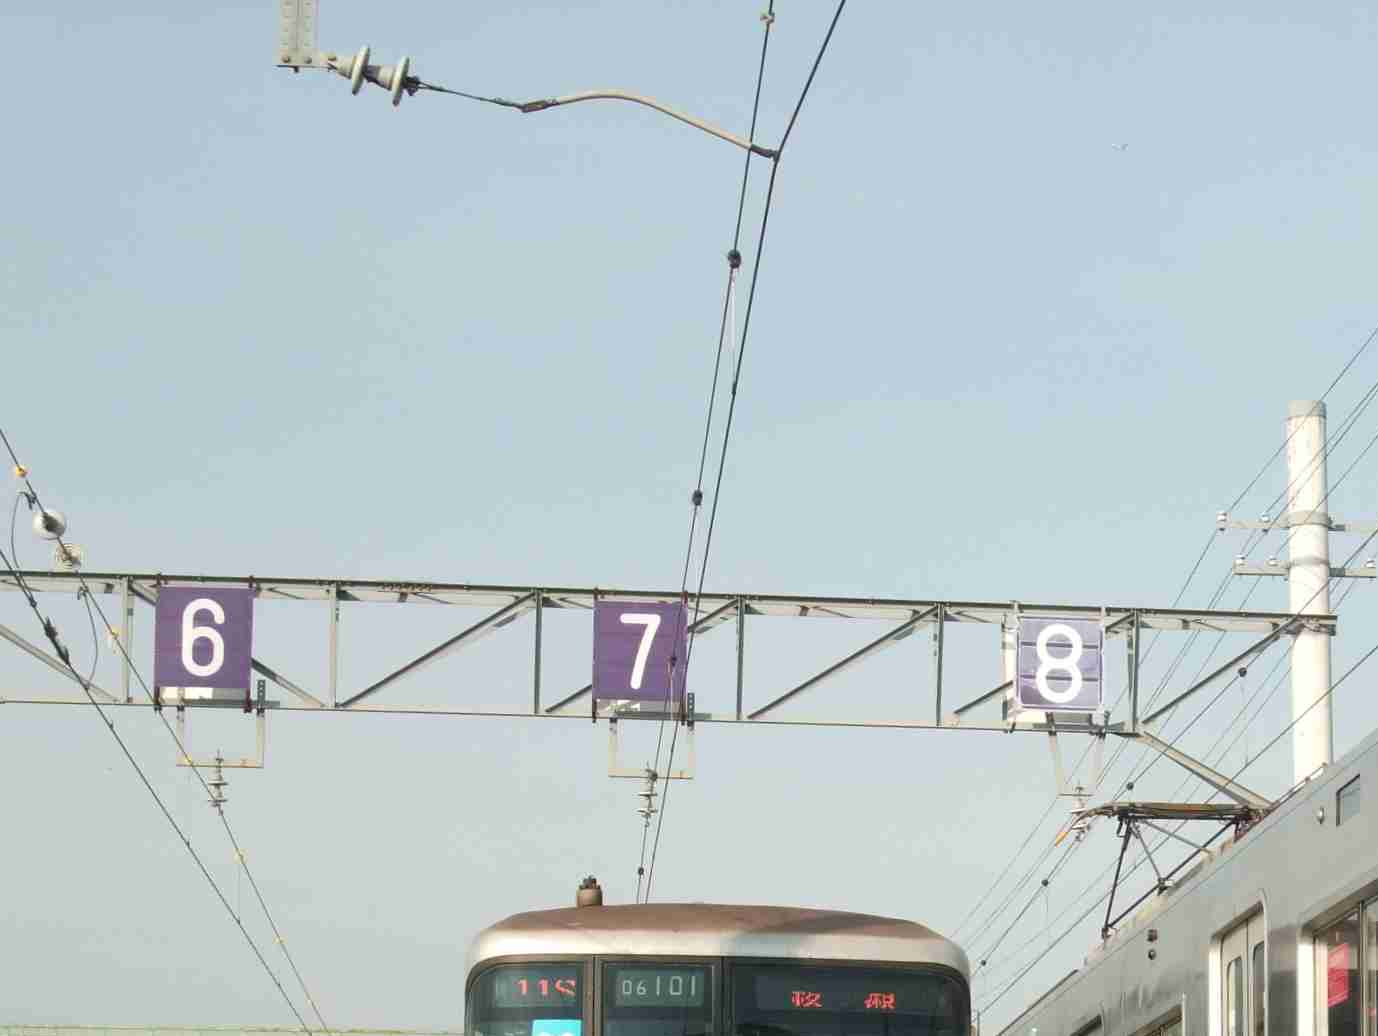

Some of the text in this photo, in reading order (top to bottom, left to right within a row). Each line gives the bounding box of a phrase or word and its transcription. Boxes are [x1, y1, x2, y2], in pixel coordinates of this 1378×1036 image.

[182, 598, 225, 678] 6
[619, 613, 662, 690] 7
[1036, 623, 1083, 704] 8
[621, 975, 696, 997] 06101
